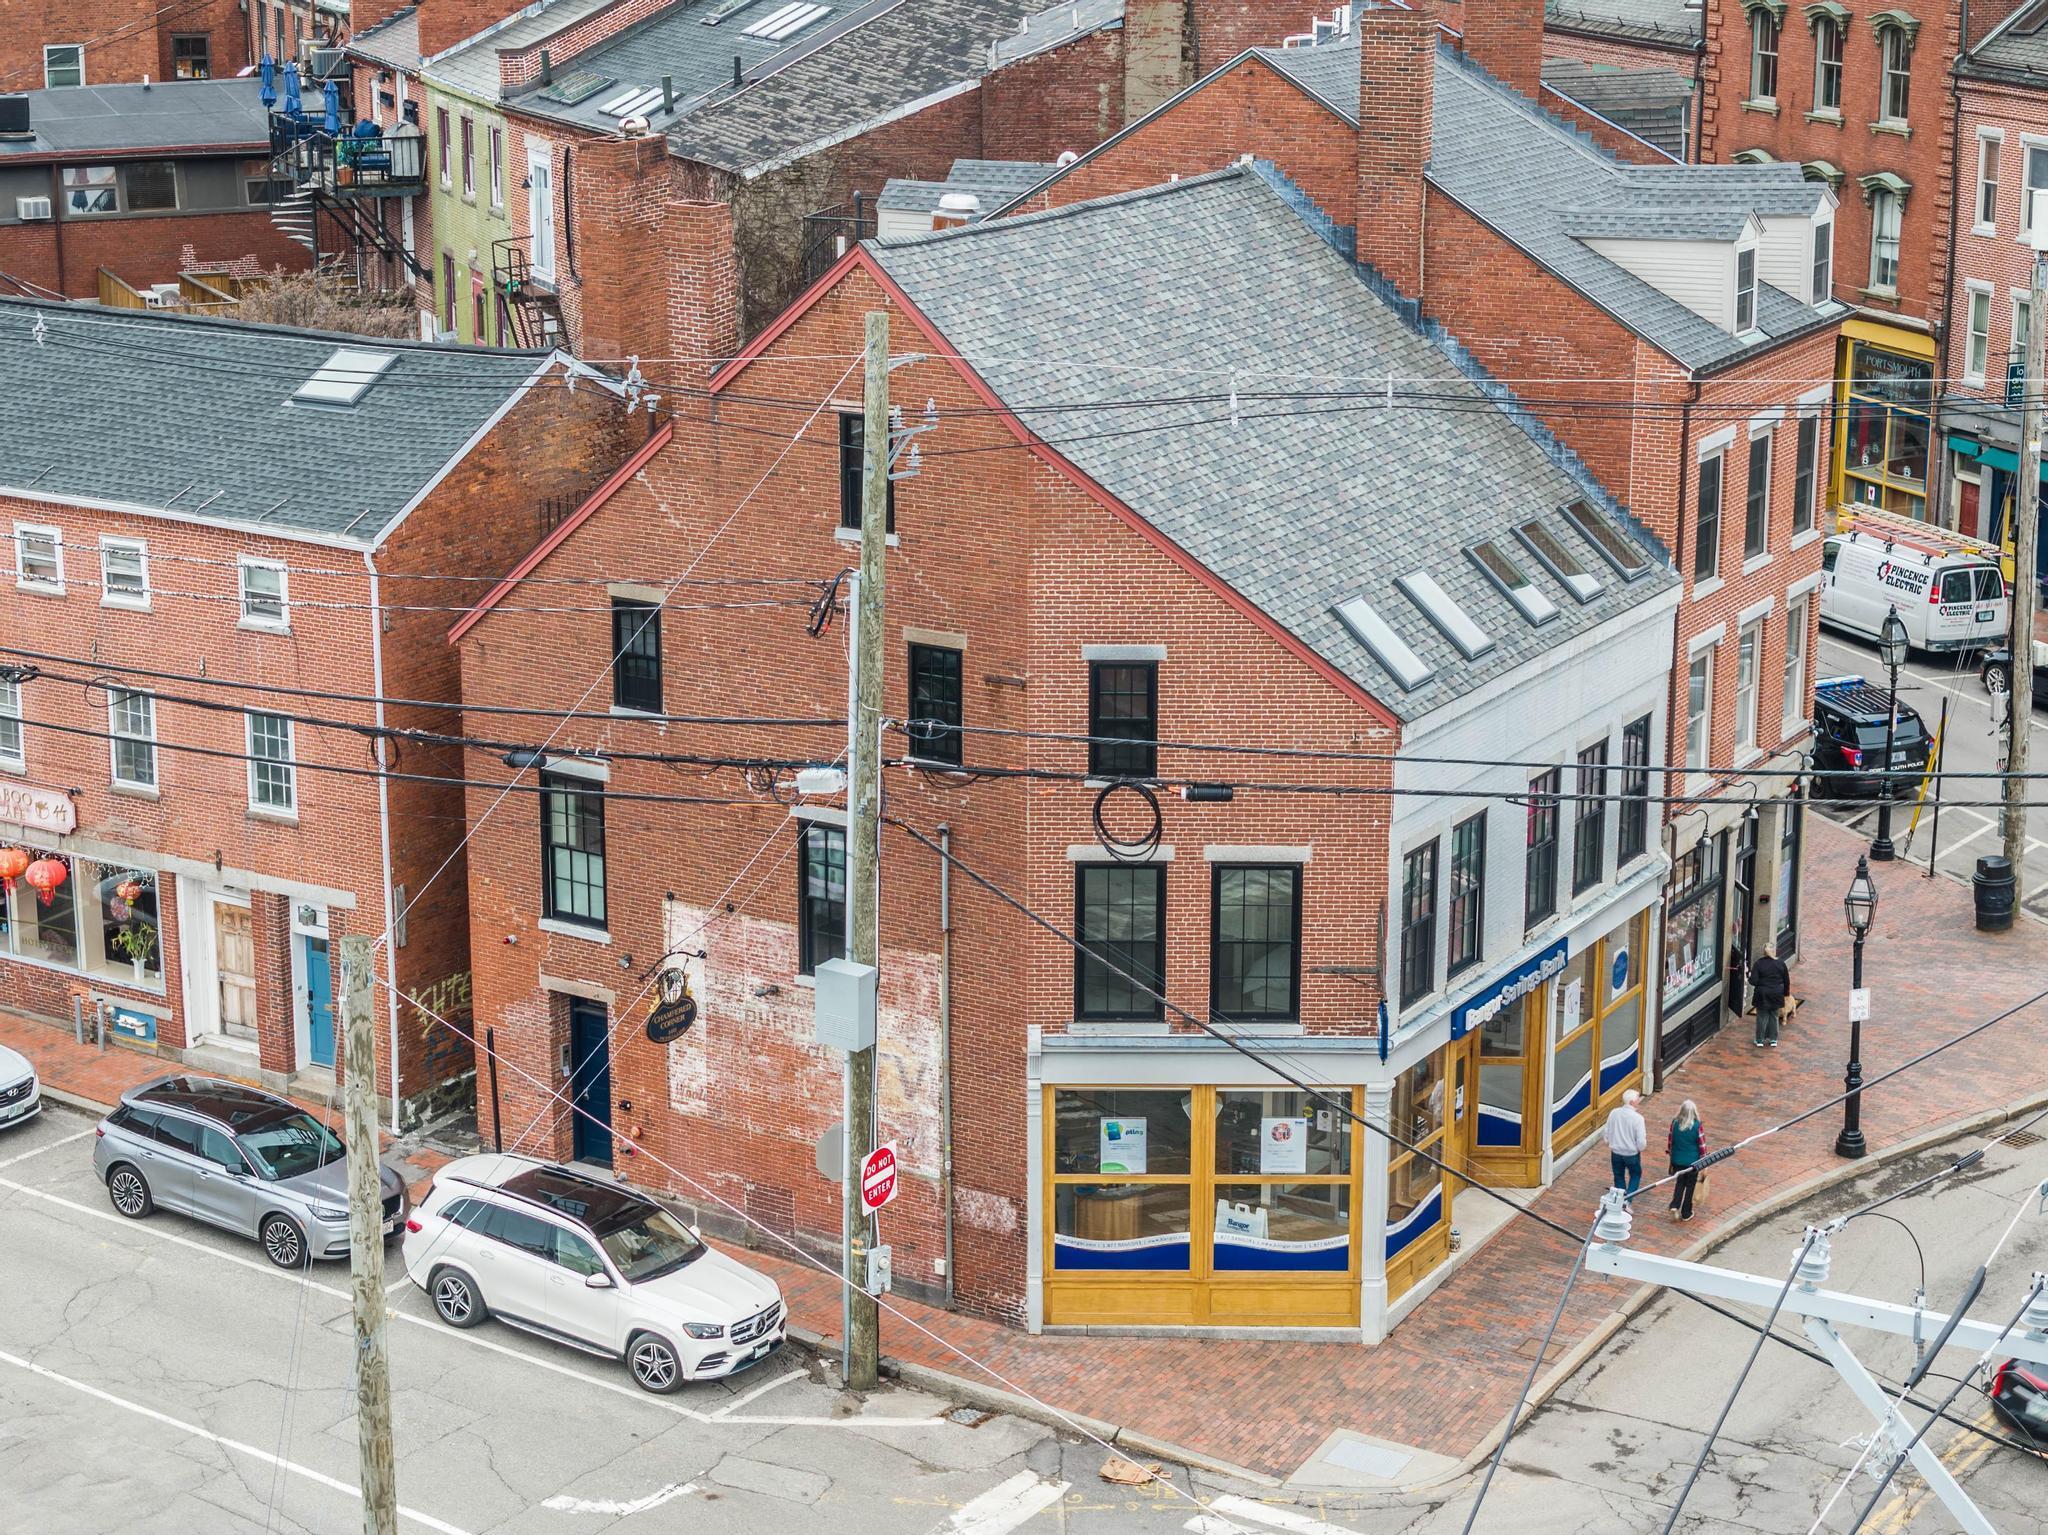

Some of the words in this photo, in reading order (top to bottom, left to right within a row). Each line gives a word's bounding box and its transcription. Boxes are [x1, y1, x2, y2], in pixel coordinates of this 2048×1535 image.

[1866, 355, 1921, 378] PORTSMOUTH
[1886, 575, 1923, 595] ELECTRIC
[1891, 565, 1929, 585] PINCENCE
[1907, 760, 1925, 769] POLICE
[1465, 994, 1503, 1031] Bangor
[1501, 970, 1541, 1006] Savings
[1540, 949, 1567, 981] Bank
[654, 1004, 692, 1024] CHAMFERED
[661, 1014, 686, 1030] CORNER
[866, 1164, 877, 1177] DO
[878, 1153, 892, 1169] NOT
[868, 1179, 891, 1201] ENTER
[1227, 1218, 1250, 1229] Bangor
